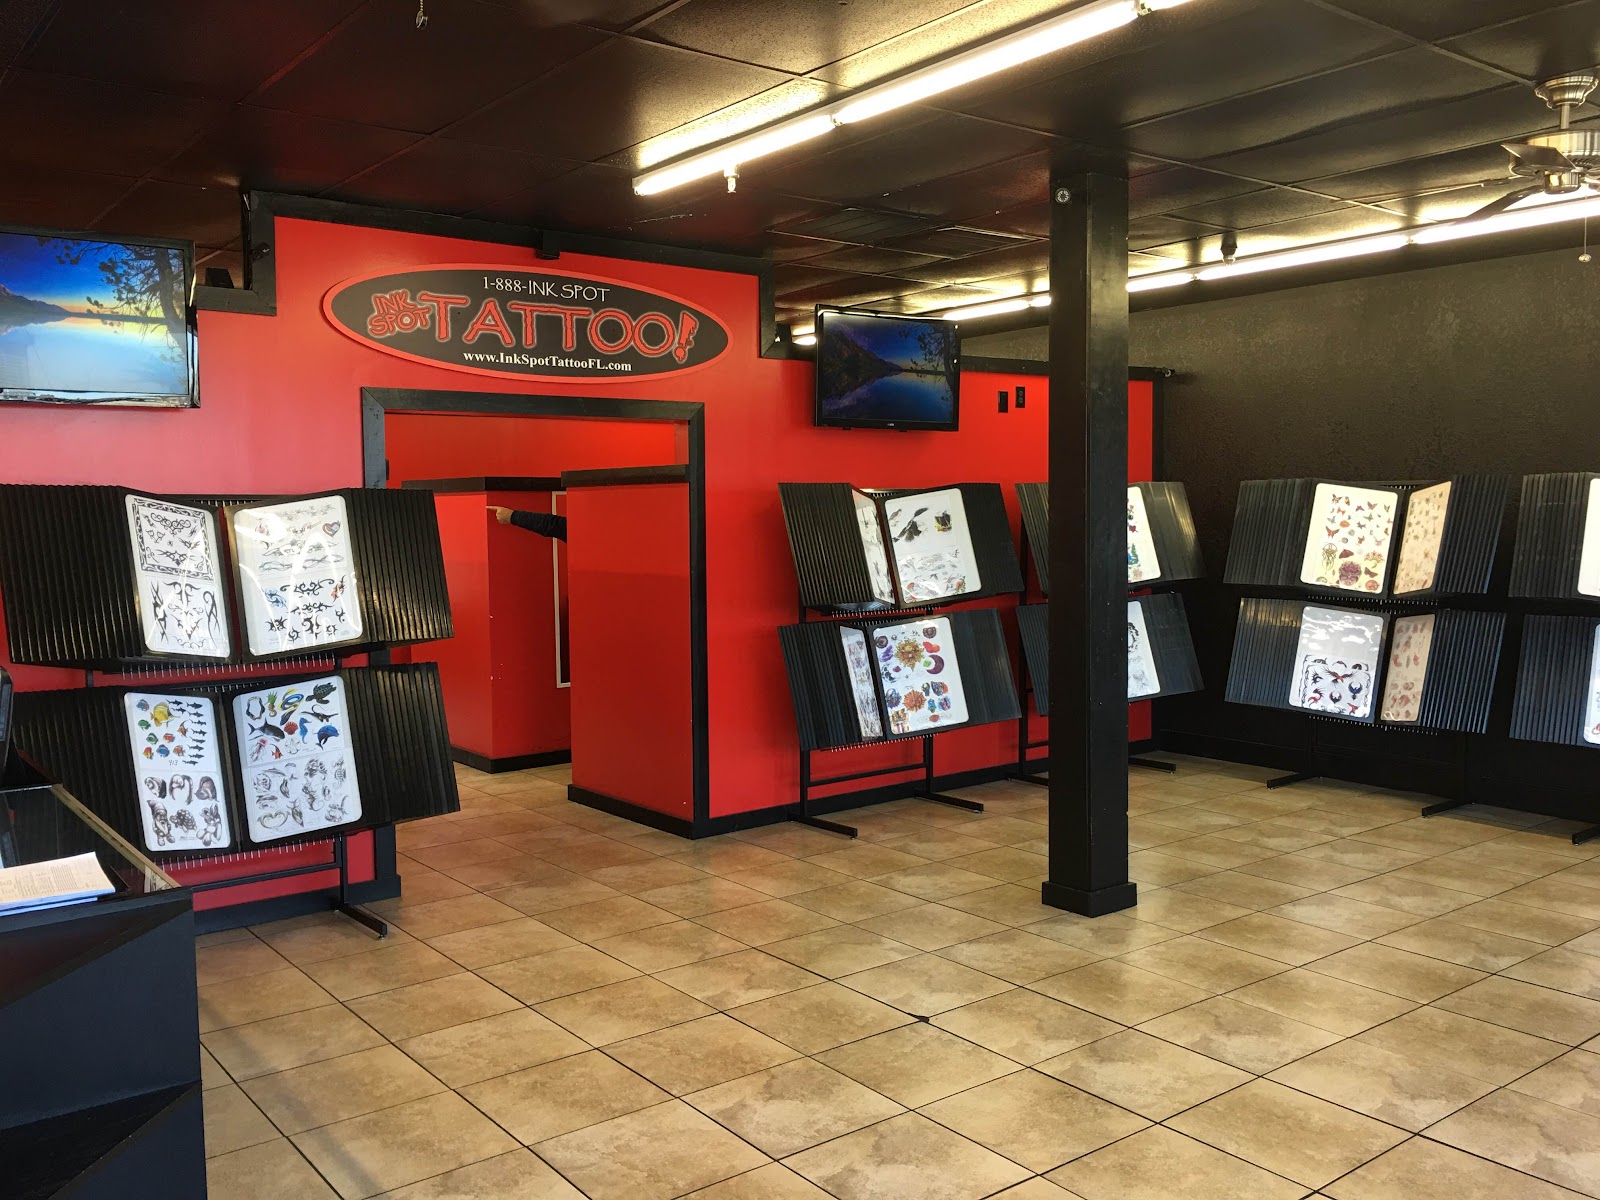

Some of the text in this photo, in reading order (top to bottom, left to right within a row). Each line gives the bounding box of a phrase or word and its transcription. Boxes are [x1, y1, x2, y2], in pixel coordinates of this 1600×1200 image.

[483, 276, 610, 302] 1-888-INK SPOT
[373, 290, 417, 315] INK
[368, 306, 431, 338] SPOT
[418, 291, 699, 363] TATTOO!
[463, 352, 632, 371] www.InkSpotTattooFL.com
